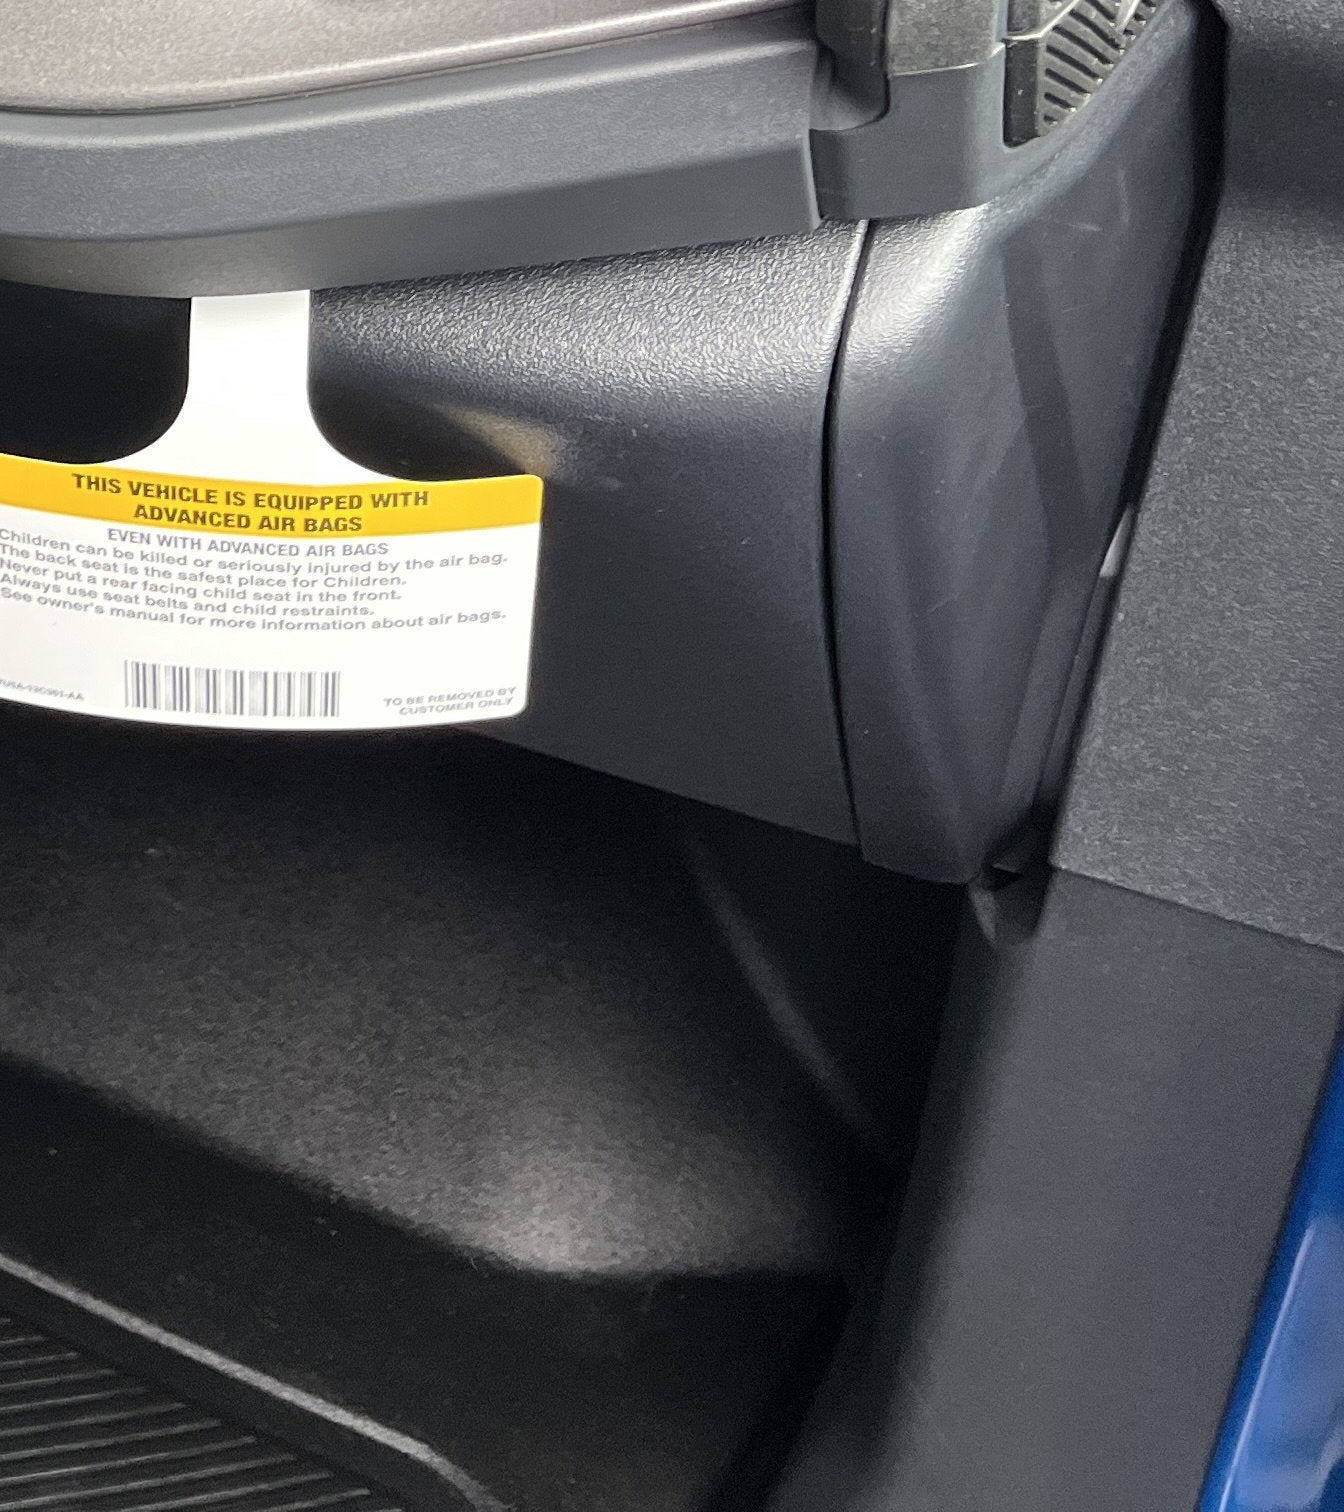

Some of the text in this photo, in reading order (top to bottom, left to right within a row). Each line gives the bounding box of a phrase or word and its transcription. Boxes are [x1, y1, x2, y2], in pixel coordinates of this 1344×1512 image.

[72, 473, 429, 511] THIS VEHICLE IS EQUIPPED WITH
[134, 504, 362, 532] ADVANCED AIR BAGS
[76, 543, 108, 556] can
[112, 545, 135, 561] be
[140, 548, 188, 566] killed
[193, 556, 213, 568] or
[218, 558, 302, 576] seriously
[308, 561, 372, 576] injured
[378, 561, 400, 576] by
[405, 557, 434, 570] the
[439, 554, 464, 568] air
[469, 551, 509, 566] bag.
[107, 528, 389, 557] EVEN WITH ADVANCED AIR BAGS
[0, 557, 403, 602] Never put a rear facing child seat in the front.
[35, 549, 78, 568] back
[82, 558, 118, 572] seat
[124, 562, 139, 576] is
[144, 565, 172, 579] the
[177, 569, 233, 586] safest
[238, 572, 287, 589] place
[293, 576, 318, 588] for
[323, 574, 408, 589] Children.
[0, 573, 376, 617] Always use seat belts and child restraints.
[0, 587, 508, 631] See owner's manual for more information about air bags.
[383, 685, 518, 708] TO BE REMOVED BY
[399, 695, 515, 717] CUSTOMER ONLY
